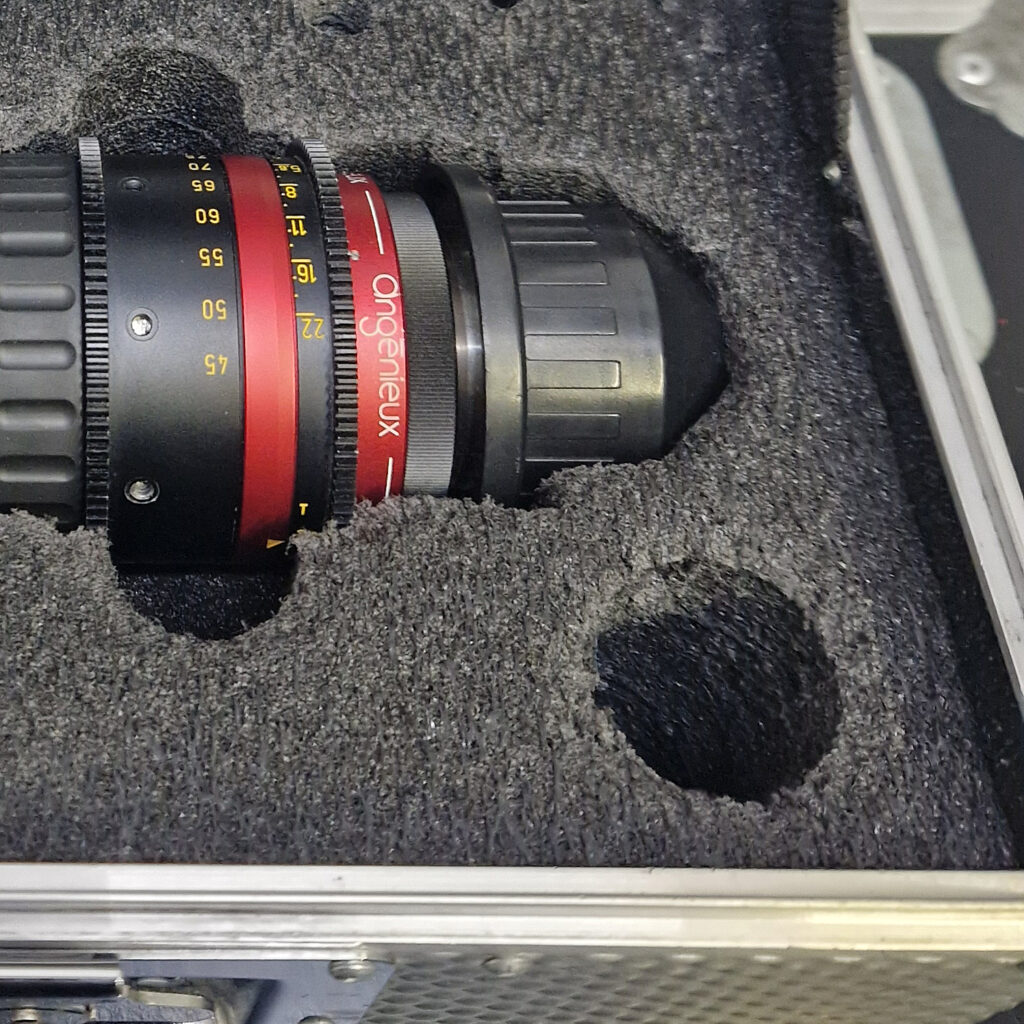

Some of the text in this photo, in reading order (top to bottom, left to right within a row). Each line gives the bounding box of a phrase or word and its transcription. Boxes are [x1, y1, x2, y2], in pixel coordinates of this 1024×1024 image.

[191, 179, 216, 192] 65
[285, 186, 298, 199] 8
[195, 208, 221, 224] 60
[290, 218, 308, 237] 11
[198, 248, 225, 268] 55
[296, 263, 317, 284] 16
[202, 298, 227, 321] 50
[301, 317, 326, 340] 22
[204, 353, 229, 377] 45
